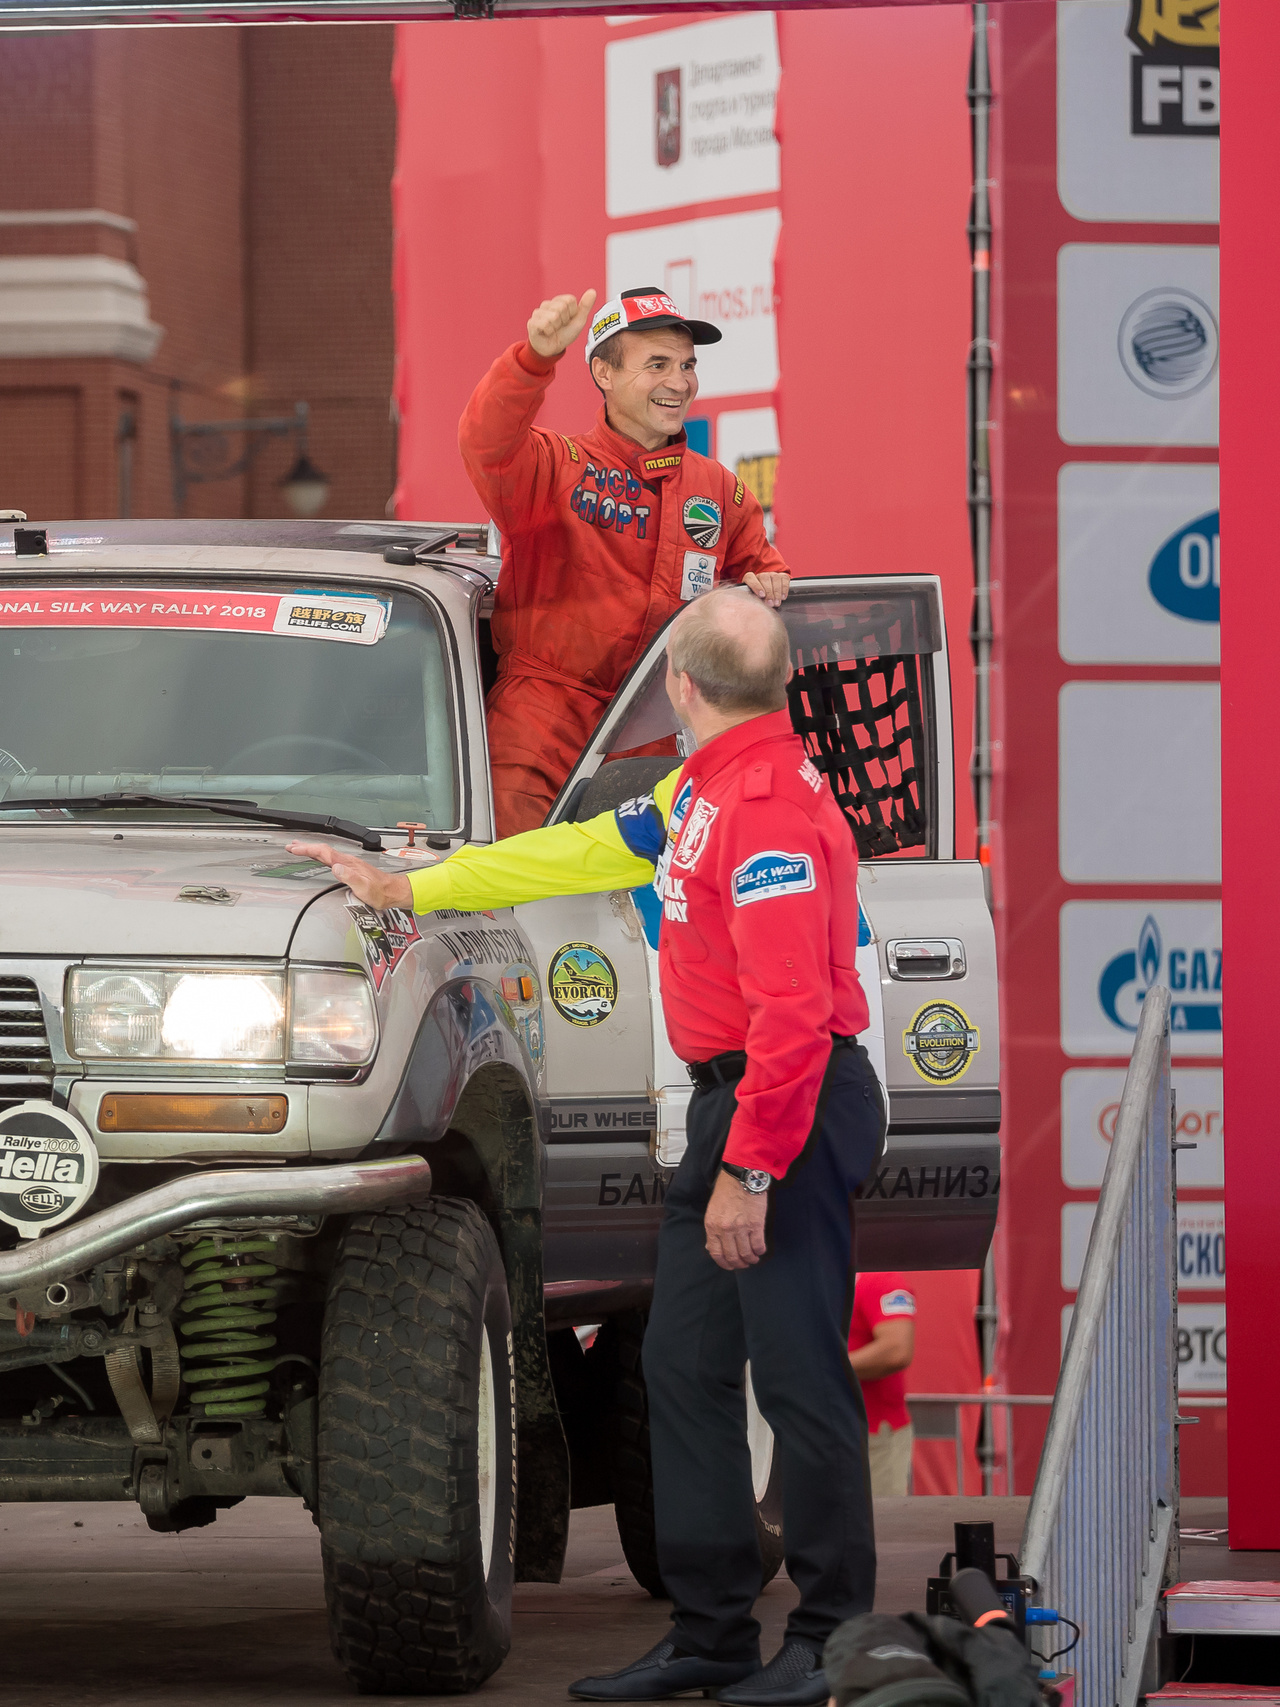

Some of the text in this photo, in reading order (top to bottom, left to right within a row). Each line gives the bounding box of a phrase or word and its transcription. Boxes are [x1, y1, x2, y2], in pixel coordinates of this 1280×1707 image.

[688, 571, 712, 585] Cotton
[49, 602, 94, 614] SILK
[100, 603, 143, 615] WAY
[150, 603, 216, 616] RALLY
[220, 605, 267, 618] 2018
[289, 618, 363, 633] FBLIFE.COM
[737, 863, 803, 888] SILK WAY
[554, 986, 614, 998] EVORACE
[920, 1037, 964, 1048] EVOLUTION
[3, 1136, 80, 1153] Rallye 1000
[23, 1193, 62, 1206] HELLA
